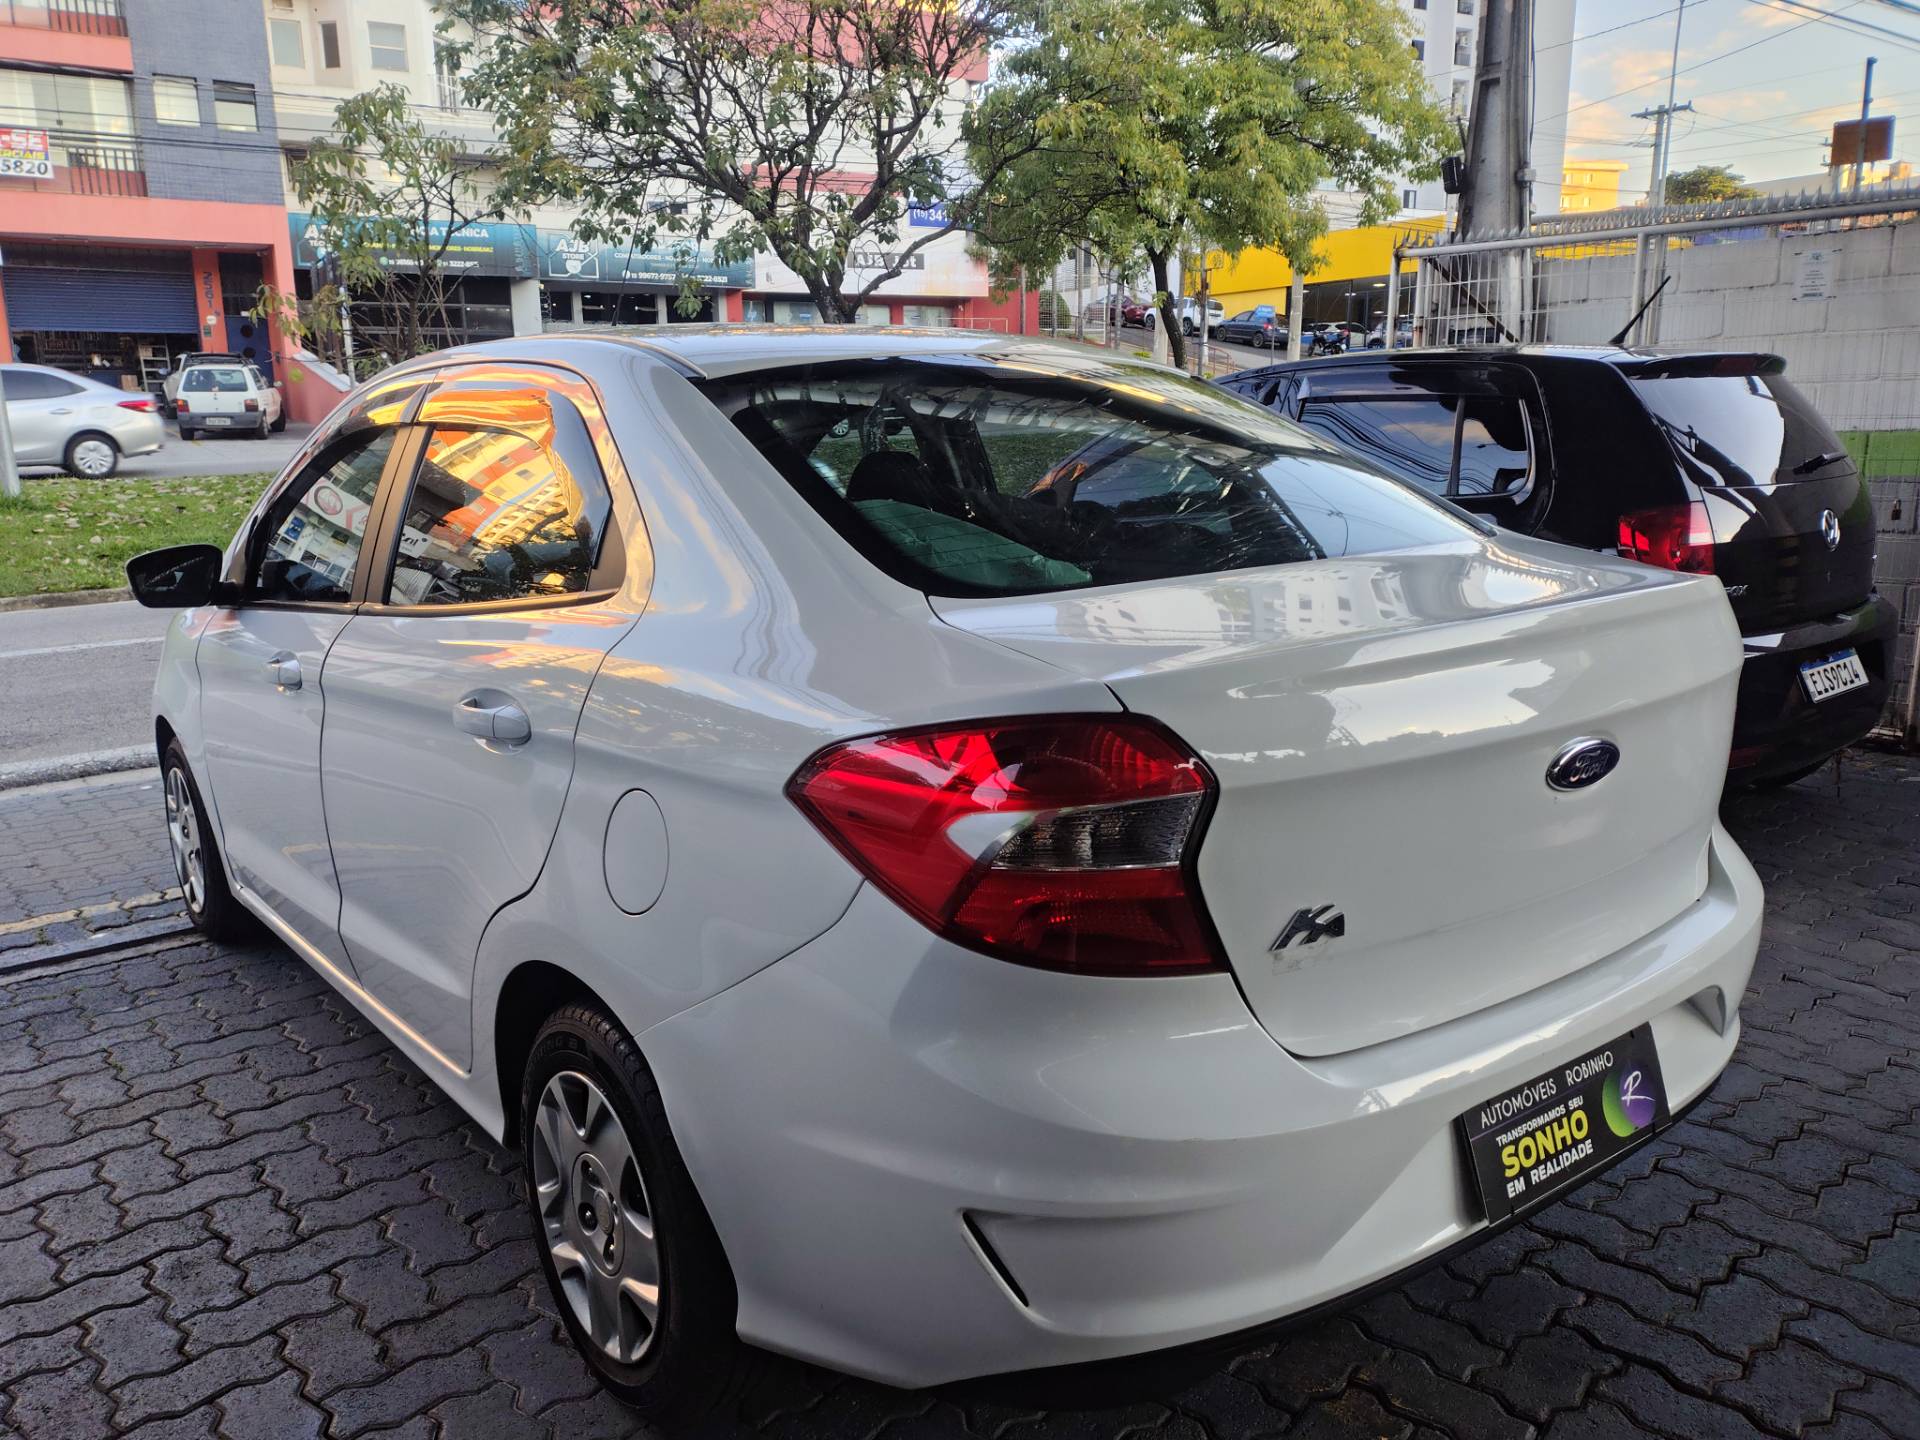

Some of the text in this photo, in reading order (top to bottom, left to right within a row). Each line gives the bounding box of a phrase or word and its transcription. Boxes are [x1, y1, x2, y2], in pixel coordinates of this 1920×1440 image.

[1, 159, 49, 175] 5820
[1809, 660, 1861, 696] EIS9C14
[1481, 1050, 1614, 1129] AUTOMÓVEIS ROBINHO
[1496, 1095, 1585, 1148] TRANSFORMAMOS SEU
[1501, 1109, 1589, 1179] SONHO
[1505, 1138, 1594, 1199] EM REALIDADE
